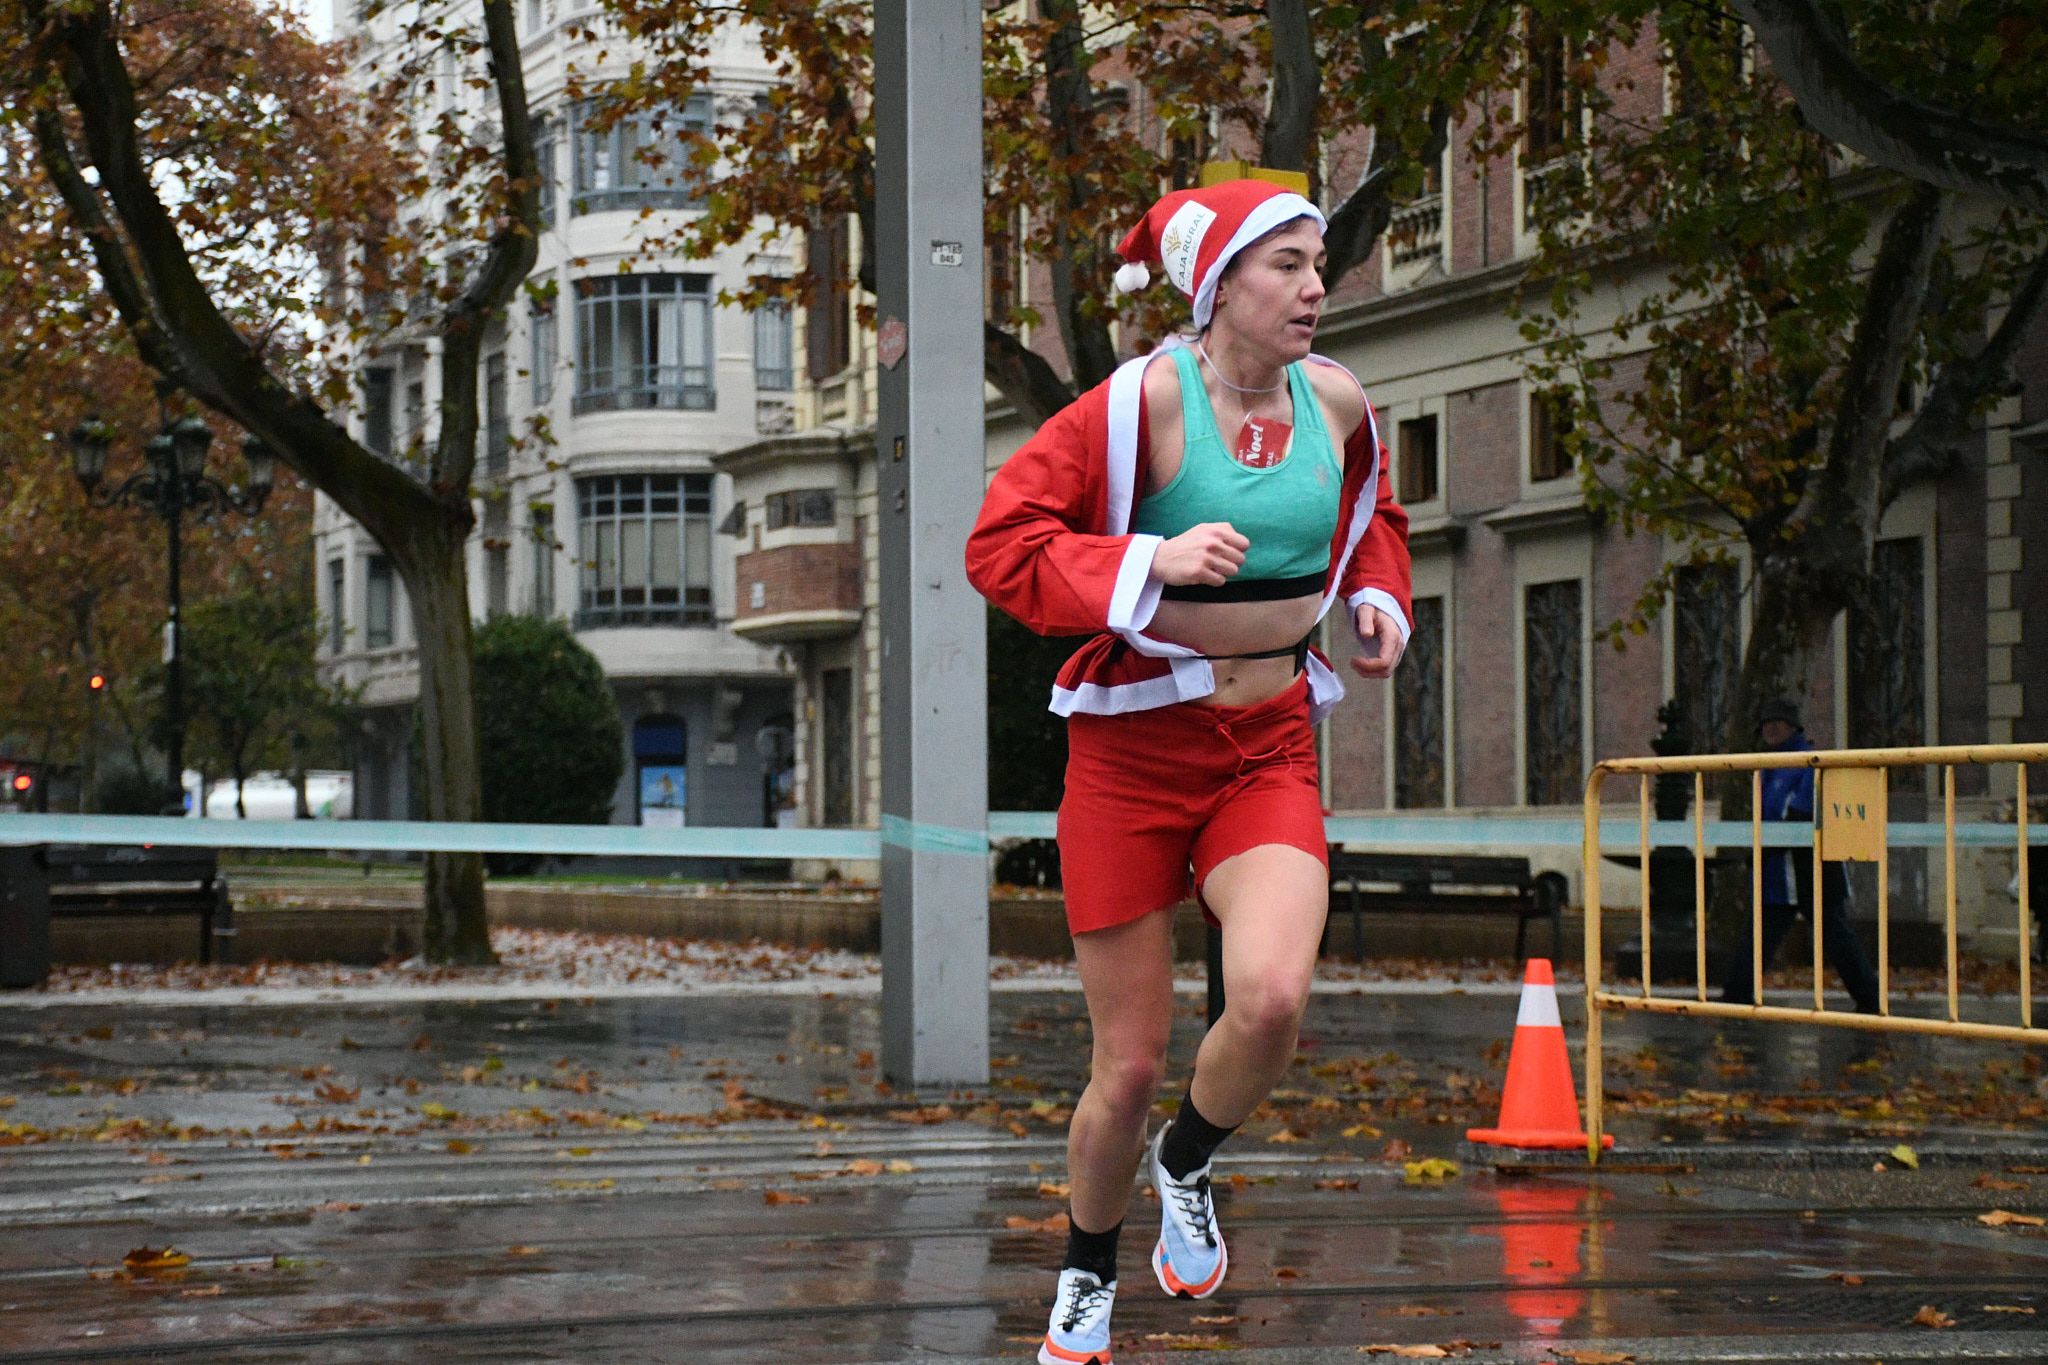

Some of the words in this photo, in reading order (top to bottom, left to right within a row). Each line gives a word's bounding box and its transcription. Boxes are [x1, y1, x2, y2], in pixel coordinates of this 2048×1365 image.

[1183, 213, 1206, 253] RURAL
[1179, 256, 1188, 287] CAJA
[1246, 423, 1264, 465] Noel
[1265, 451, 1274, 467] RAL
